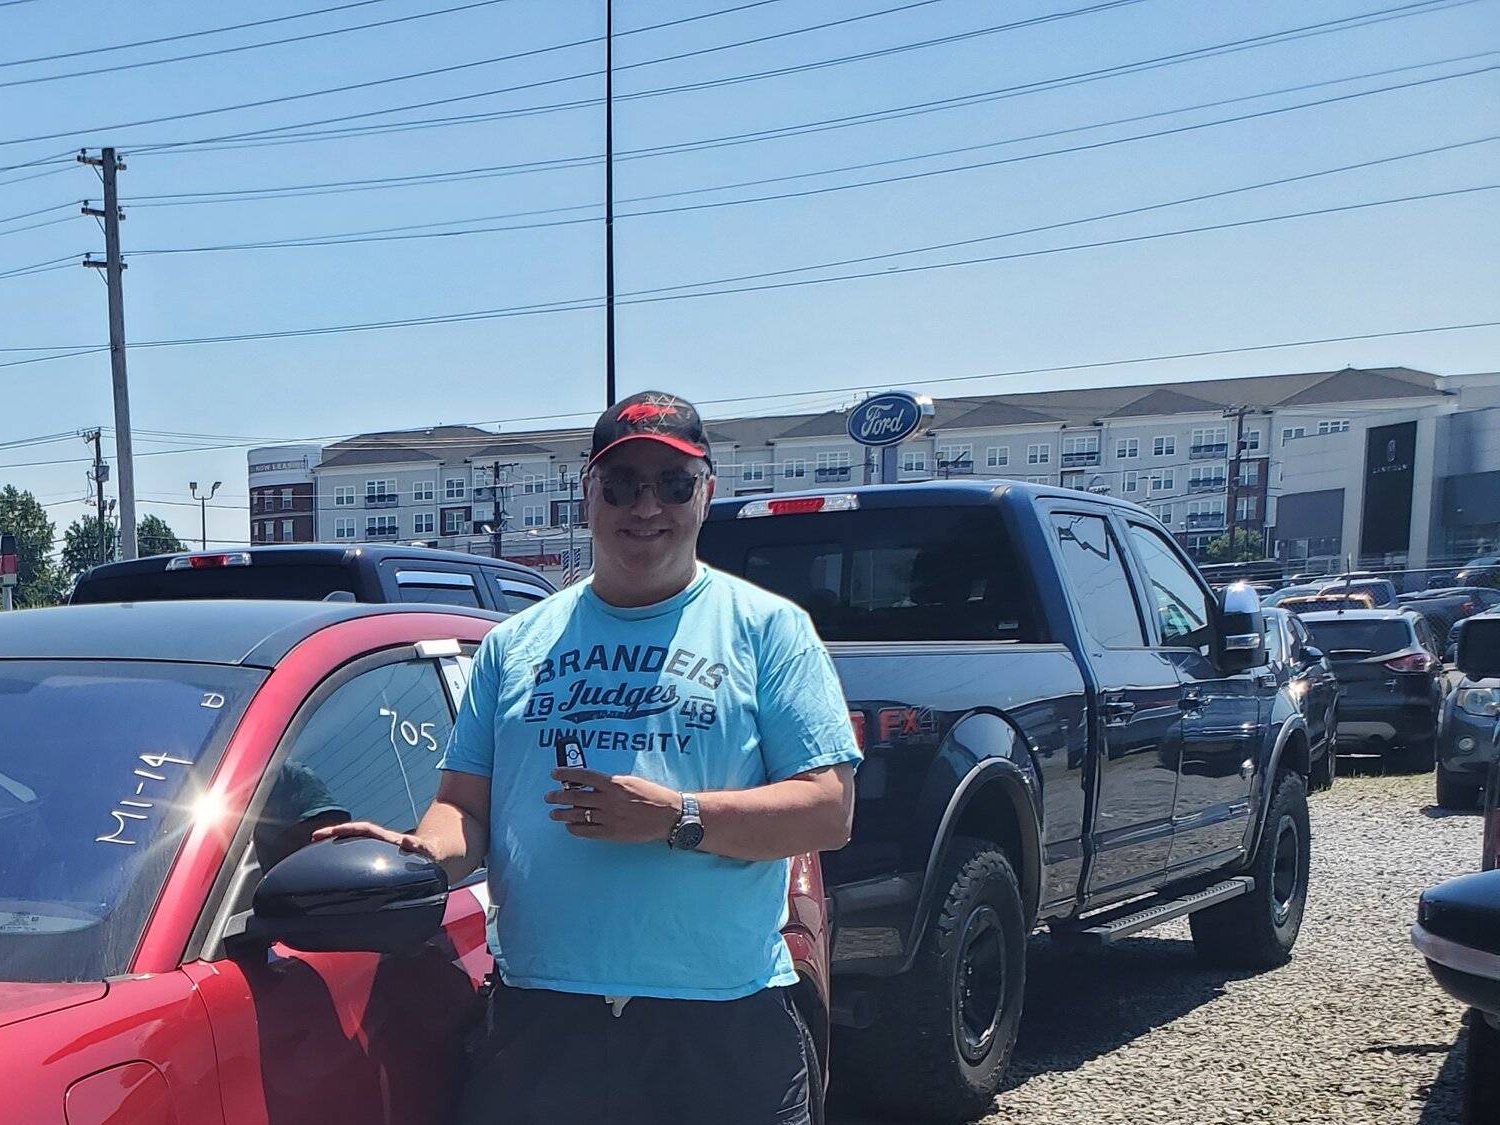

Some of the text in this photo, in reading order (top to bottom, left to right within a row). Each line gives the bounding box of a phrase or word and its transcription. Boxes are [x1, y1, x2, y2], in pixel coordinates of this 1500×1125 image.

[861, 404, 905, 437] Ford
[532, 644, 730, 691] BRANDEIS
[522, 679, 718, 726] 19 Judges 48
[538, 728, 692, 755] UNIVERSITY
